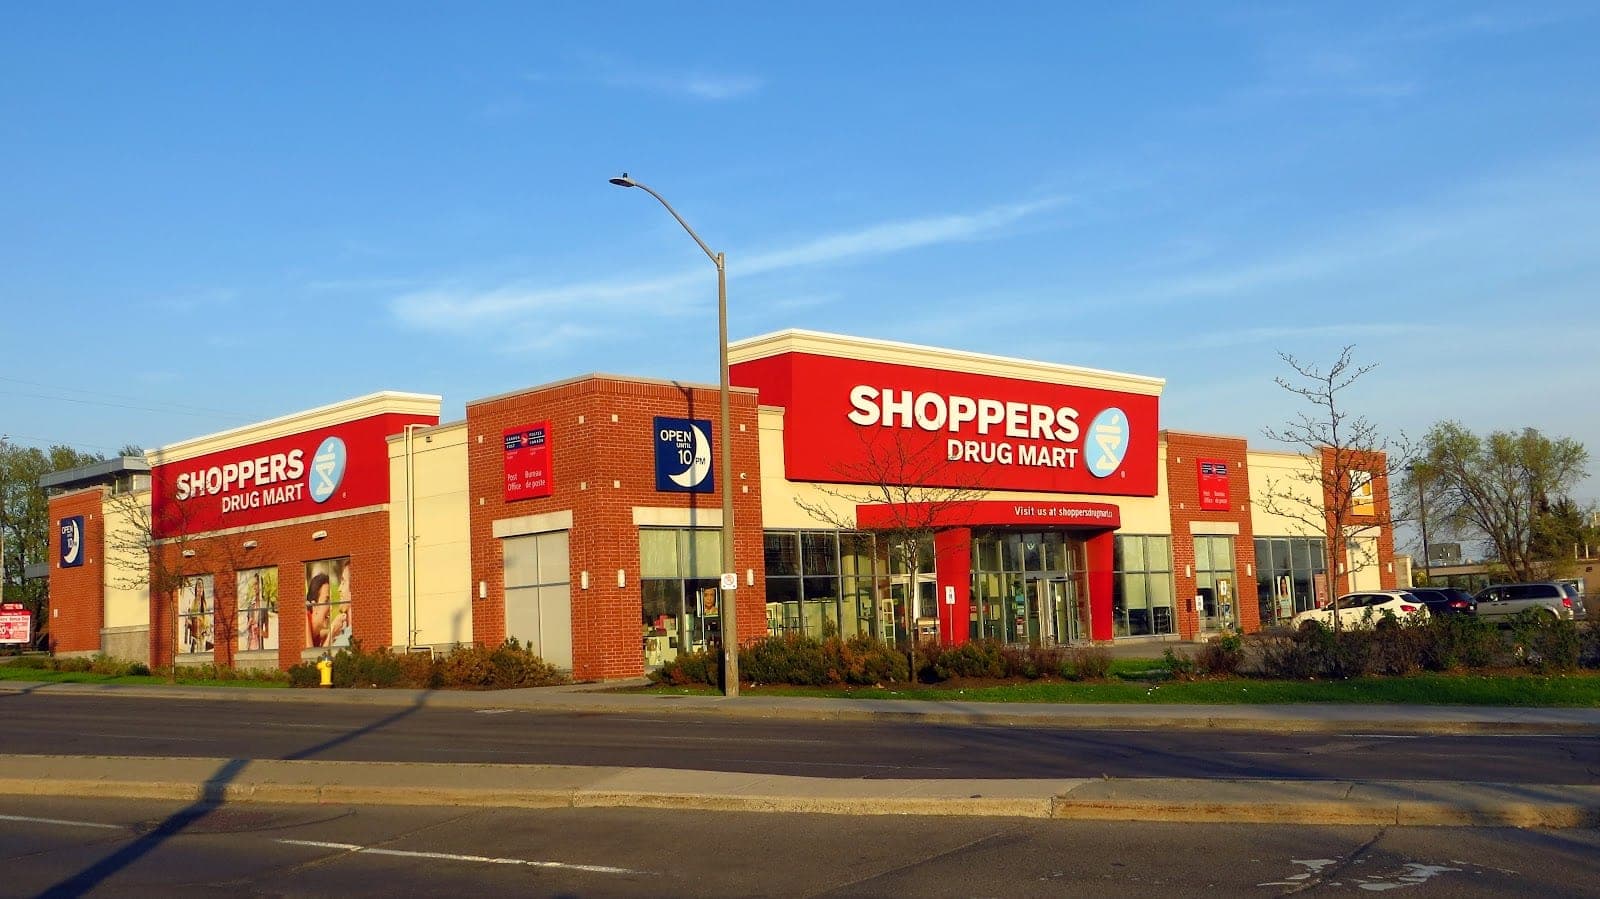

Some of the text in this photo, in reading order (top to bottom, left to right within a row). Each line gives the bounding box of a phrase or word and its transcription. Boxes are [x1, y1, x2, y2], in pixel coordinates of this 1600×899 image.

[848, 384, 1080, 442] SHOPPERS
[660, 429, 692, 442] OPEN
[678, 450, 692, 465] 10
[947, 439, 1078, 469] DRUG MART
[176, 449, 304, 500] SHOPPERS
[508, 483, 522, 491] Office
[526, 479, 545, 489] de poste
[222, 482, 304, 514] DRUG MART
[1014, 506, 1034, 516] Visit
[1049, 508, 1056, 516] at
